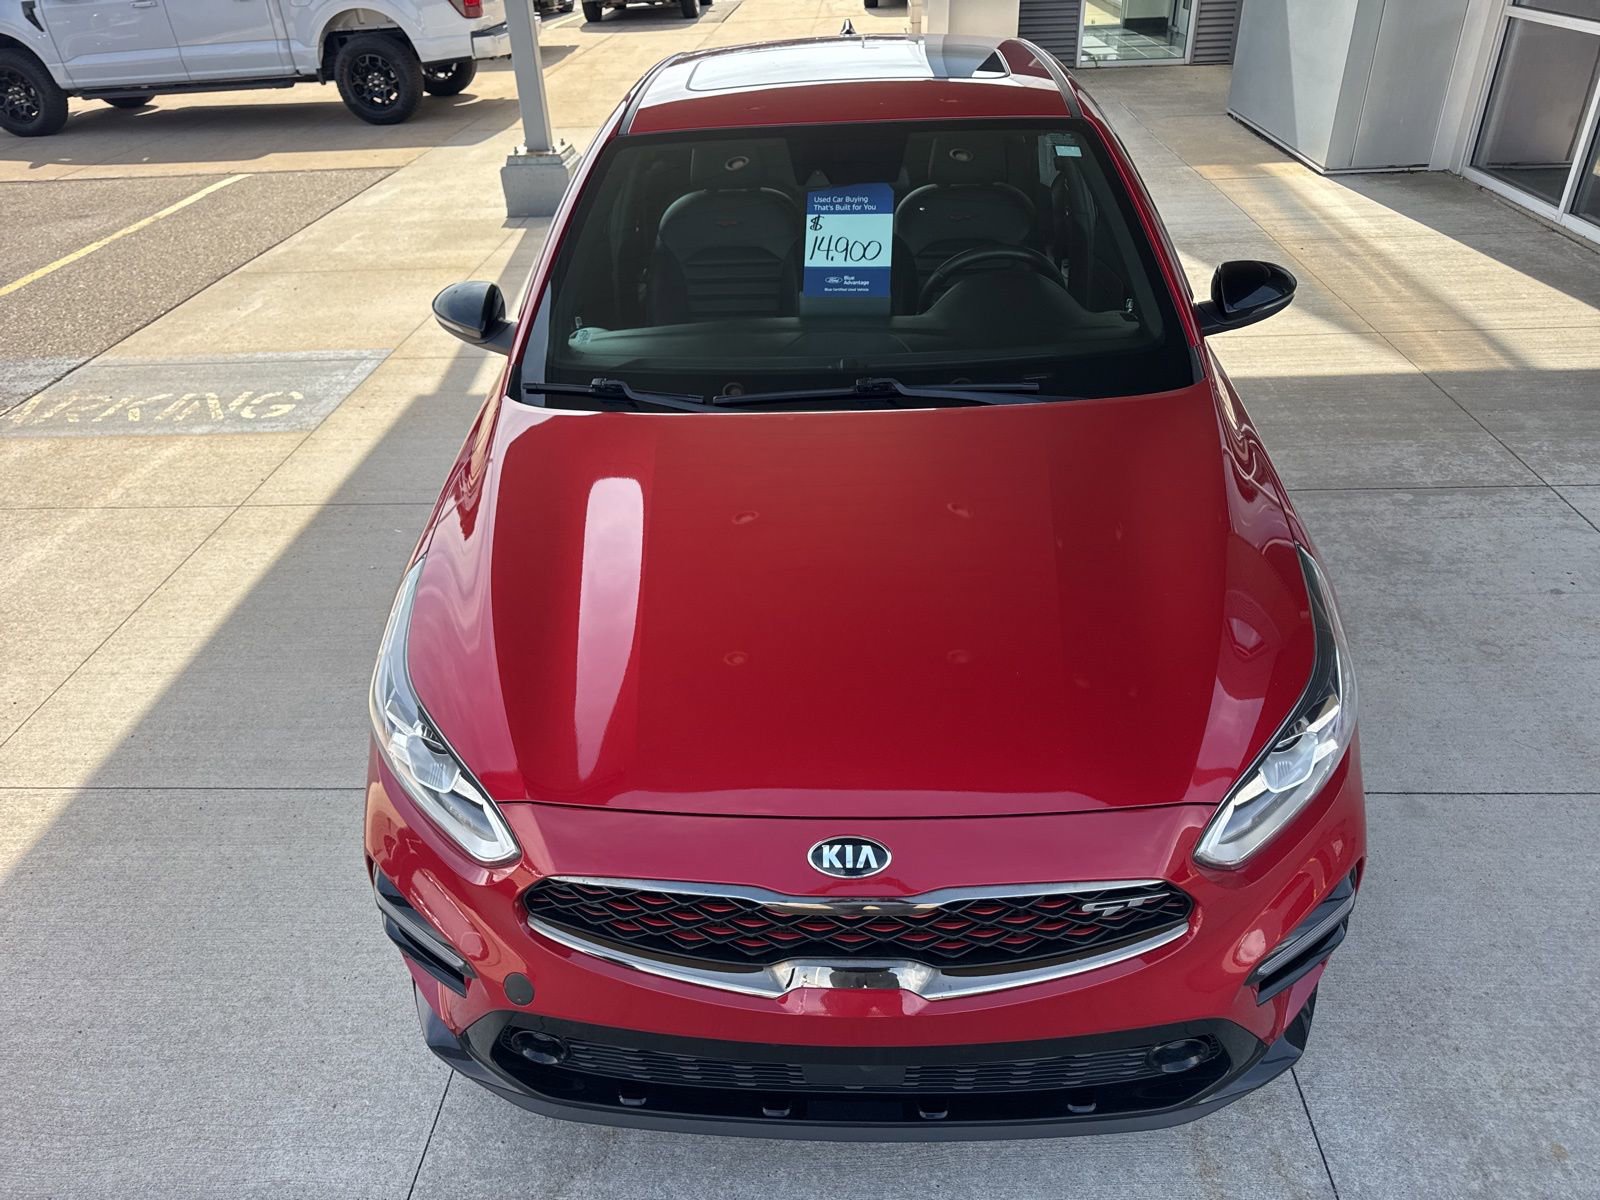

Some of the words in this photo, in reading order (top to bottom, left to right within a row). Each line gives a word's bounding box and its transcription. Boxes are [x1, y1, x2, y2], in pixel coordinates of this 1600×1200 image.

[845, 196, 869, 204] Buying
[809, 215, 825, 231] $
[821, 844, 879, 869] KIA
[1081, 892, 1171, 917] GT
